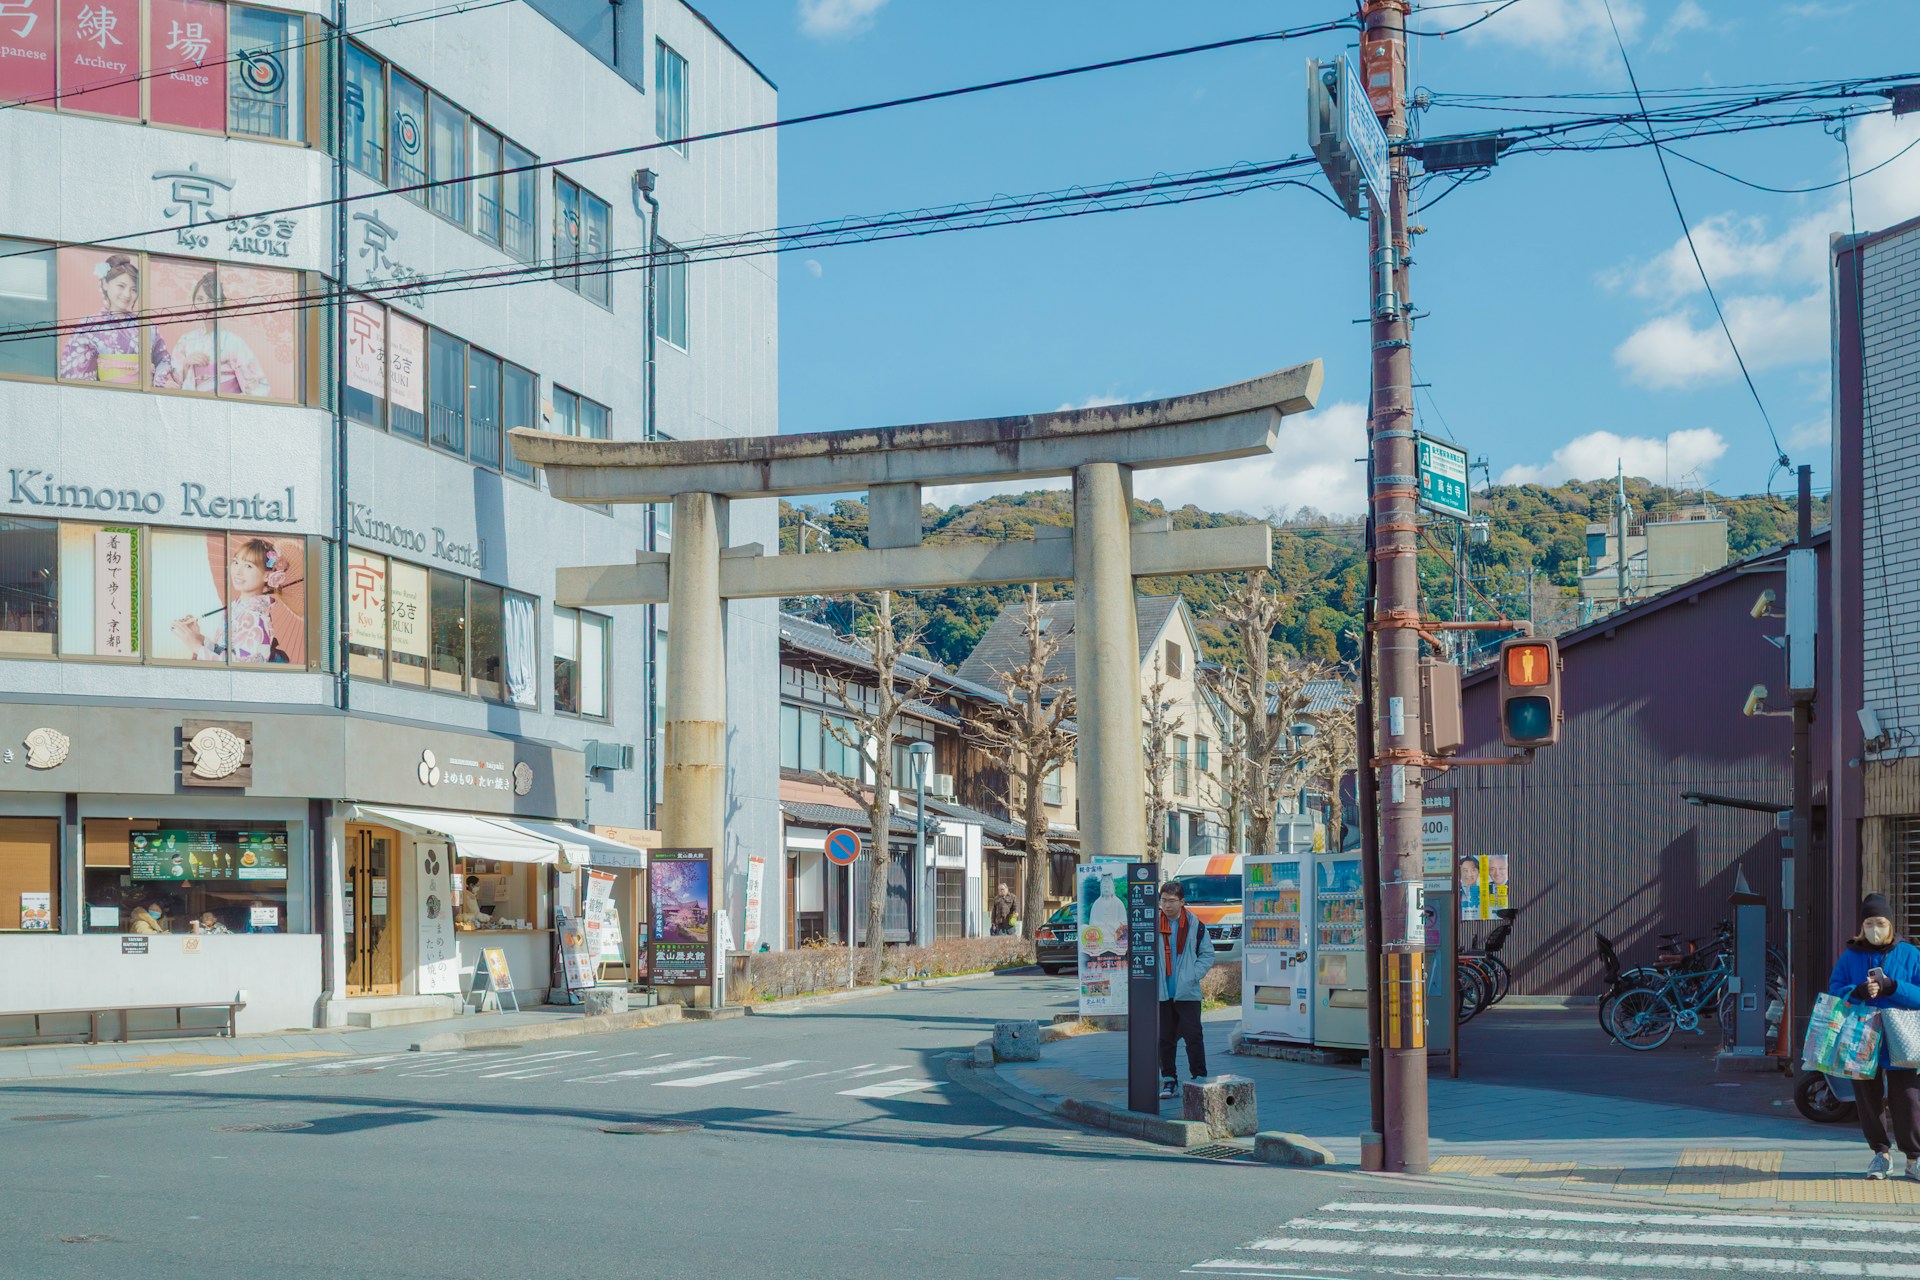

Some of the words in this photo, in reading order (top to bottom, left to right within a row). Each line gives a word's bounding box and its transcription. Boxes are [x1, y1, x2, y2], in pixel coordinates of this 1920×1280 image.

[76, 4, 123, 49] 練
[165, 20, 211, 64] 場
[74, 53, 127, 73] Archery
[169, 68, 209, 86] Range
[152, 161, 237, 227] 京
[177, 228, 209, 250] Kyo
[227, 236, 289, 257] ARUKI
[353, 208, 399, 271] 京
[347, 305, 381, 354] 京
[8, 468, 165, 516] Kimono
[180, 482, 298, 523] Rental
[348, 501, 427, 553] Kimono
[431, 526, 488, 571] Rental
[348, 558, 384, 610] 京
[357, 611, 373, 628] Kyo
